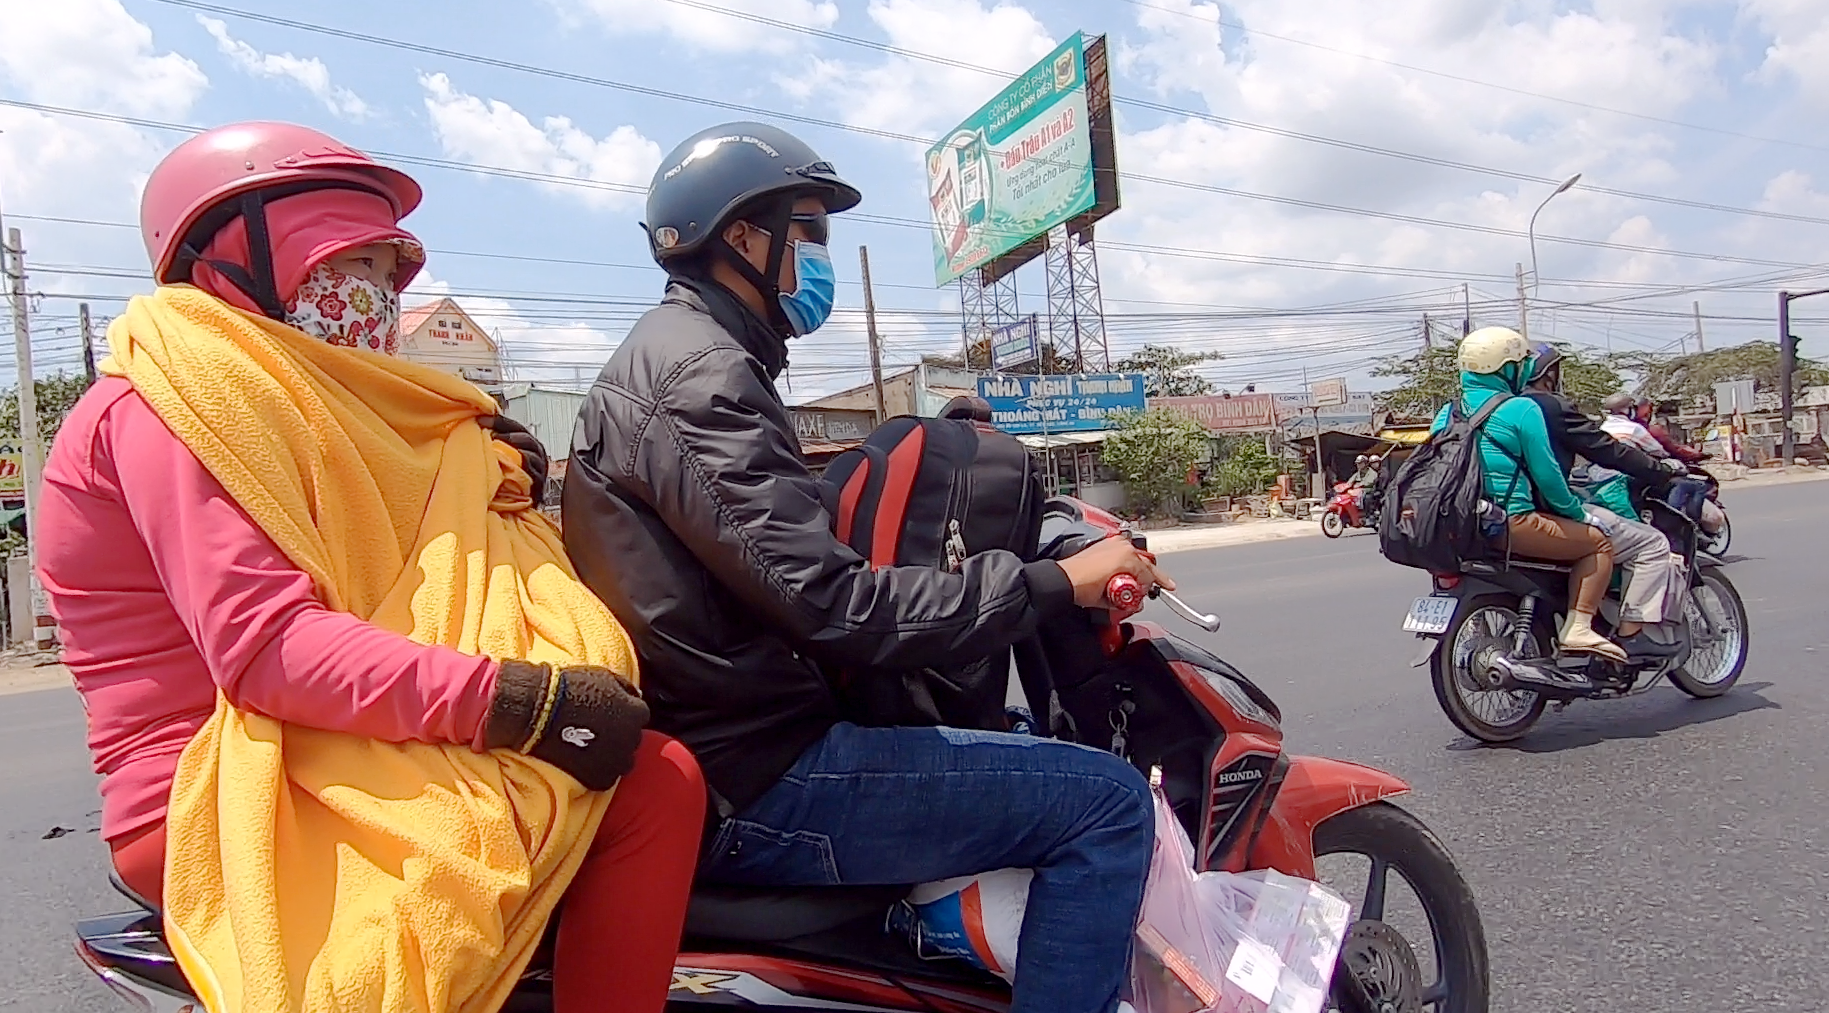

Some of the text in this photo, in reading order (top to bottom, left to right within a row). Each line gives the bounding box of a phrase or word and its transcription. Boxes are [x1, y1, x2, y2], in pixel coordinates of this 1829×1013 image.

[1009, 90, 1018, 105] TY
[1062, 107, 1075, 133] A2
[984, 378, 1024, 397] NHÀ
[1219, 769, 1262, 784] HONDA
